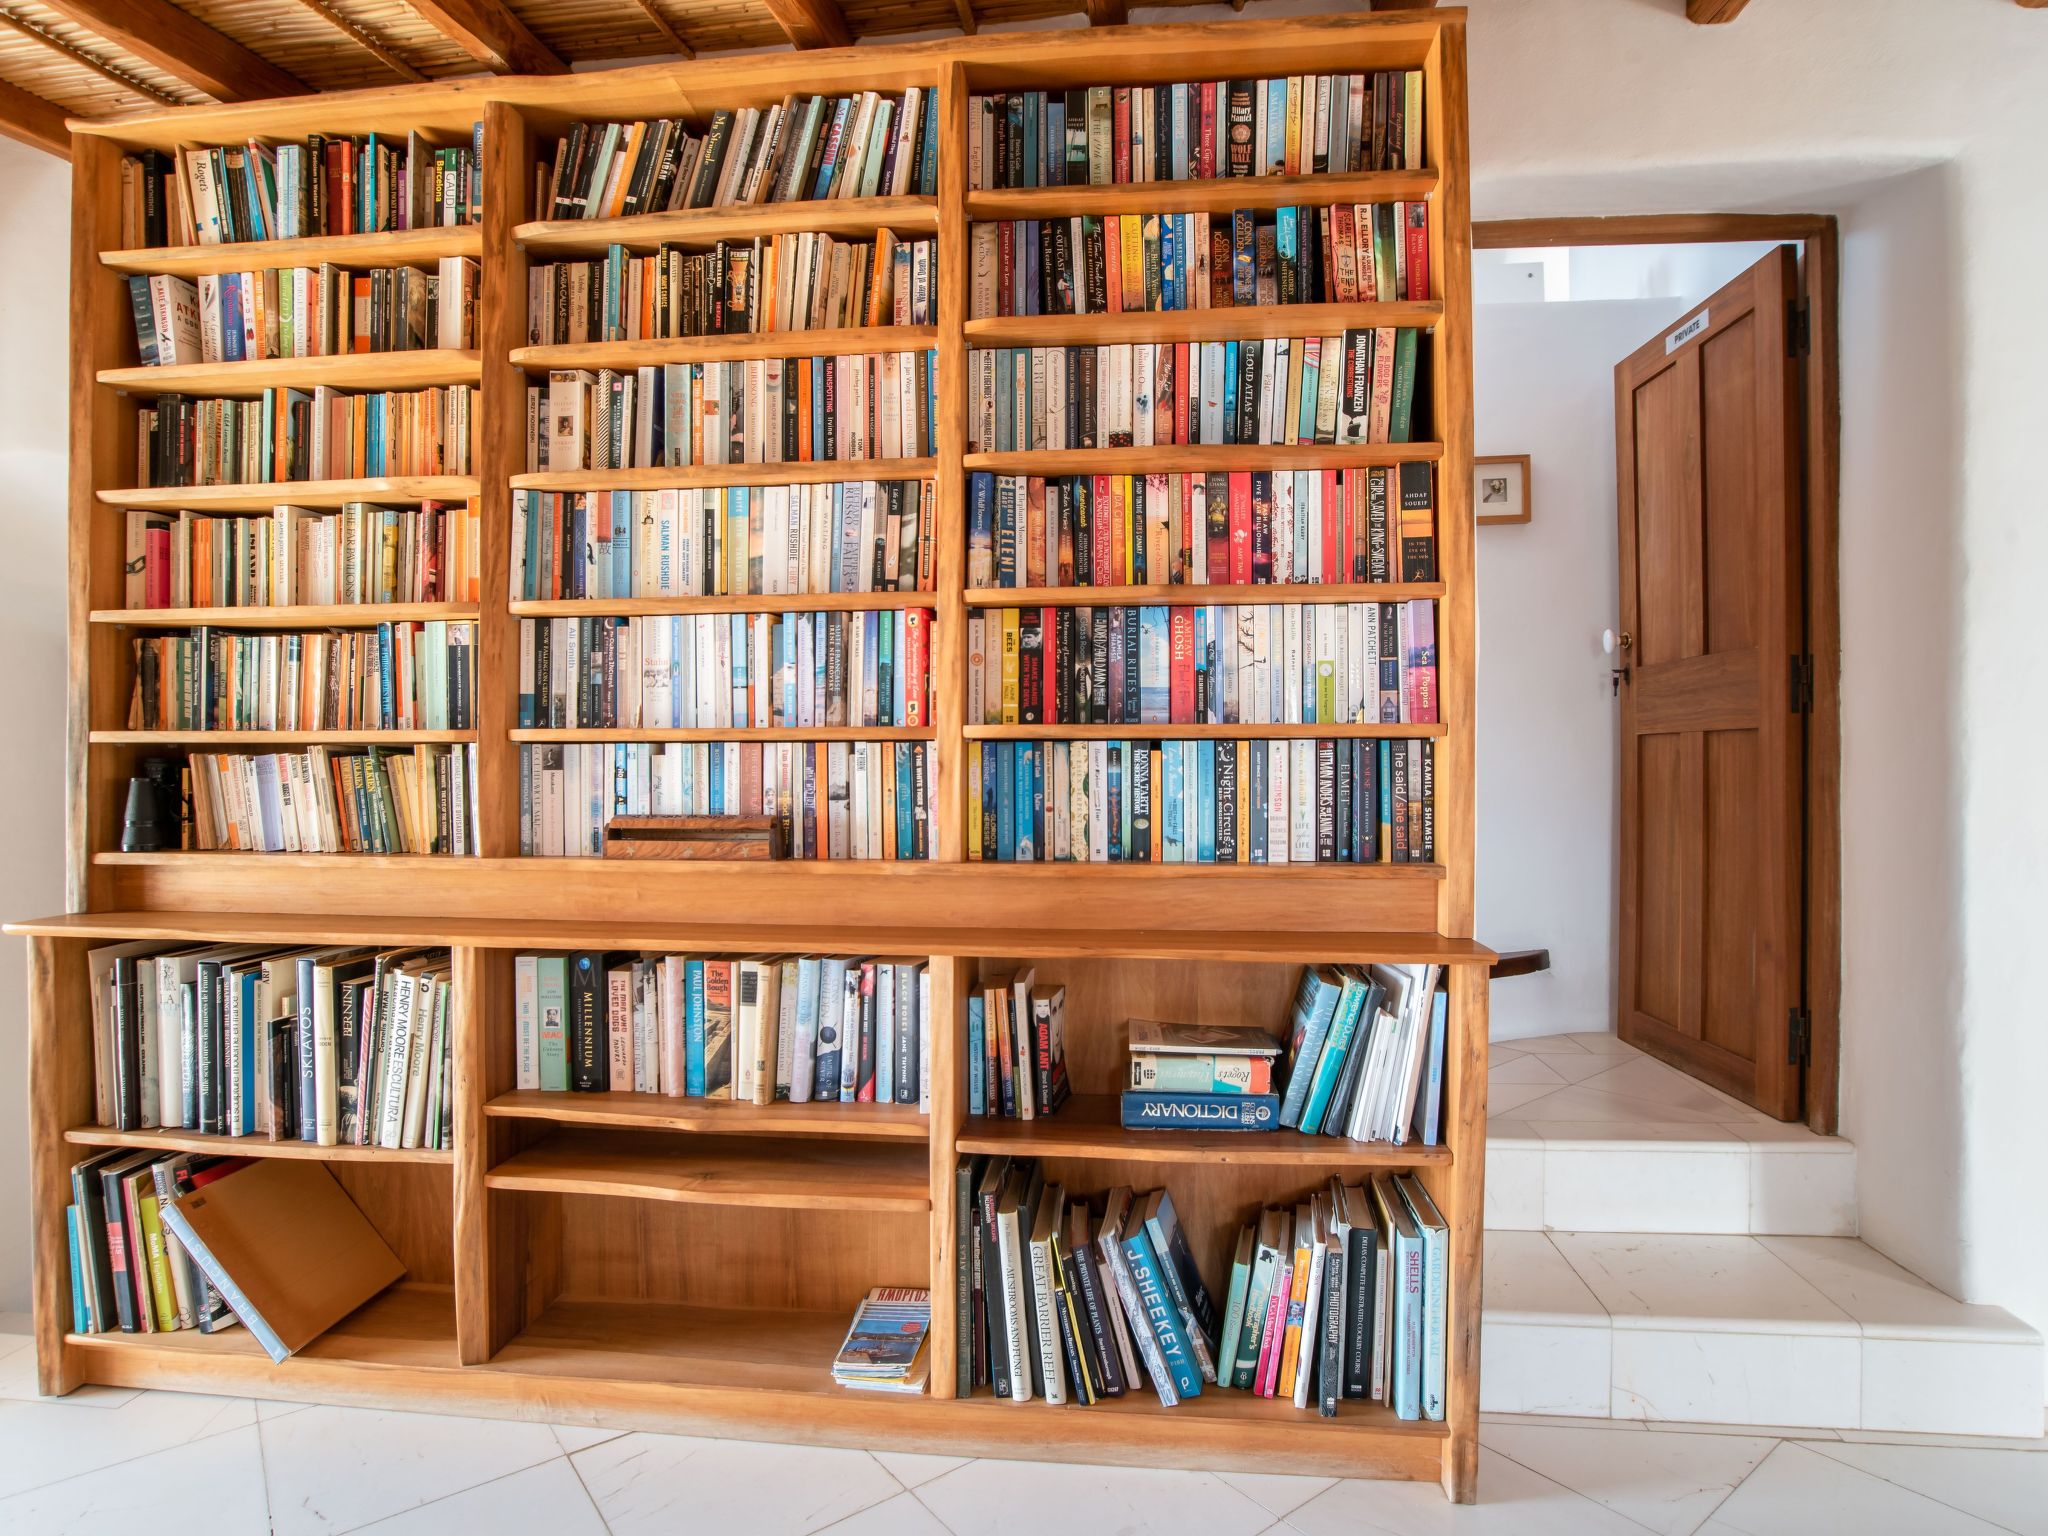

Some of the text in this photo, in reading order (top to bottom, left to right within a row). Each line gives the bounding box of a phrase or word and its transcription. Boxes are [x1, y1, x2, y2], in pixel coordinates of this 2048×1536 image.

[704, 116, 725, 165] My Struggle
[823, 123, 842, 165] CASSINI
[194, 162, 208, 192] Roget's
[435, 160, 444, 202] Barcelona
[658, 149, 674, 180] TALIBAN
[1056, 235, 1064, 271] OUTCAST
[1244, 221, 1252, 244] CONN
[1361, 224, 1370, 255] ELLORY
[682, 262, 692, 291] Victory
[159, 304, 168, 333] ATKINSON
[1674, 320, 1700, 344] PRIVATE
[1353, 335, 1366, 412] JONATHAN FRANZEN
[1244, 383, 1252, 412] ATLAS
[347, 506, 355, 527] THE
[977, 489, 985, 530] Wildflowers
[1016, 493, 1024, 524] Elephant
[1370, 501, 1384, 521] SAVED
[347, 528, 355, 545] FAR
[661, 520, 670, 590] SALMAN RUSHDIE
[790, 528, 798, 561] RUSHDIE
[1001, 529, 1014, 572] ELENI
[1370, 528, 1384, 545] KING
[1371, 548, 1385, 575] SWEDEN
[1128, 610, 1136, 692] BURIAL RITES
[1175, 615, 1183, 660] GHOSH
[1368, 607, 1377, 666] ANN PATCHETT
[354, 757, 363, 789] TOLKIEN
[364, 757, 376, 792] TOLKIEN
[1140, 749, 1149, 814] DONNA TARTT
[1320, 750, 1333, 778] HITMAN
[1340, 764, 1350, 804] ELMET
[1220, 764, 1234, 842] Night Circus
[1320, 780, 1333, 806] ANDERS
[1395, 753, 1407, 850] he said/she said
[343, 985, 353, 1037] BERNINI
[379, 991, 389, 1053] Cornelis ZITMAN
[693, 970, 702, 1042] PAUL JOHNSTON
[1347, 987, 1365, 1025] Lawrence
[300, 1007, 313, 1078] SKLAVOS
[412, 1008, 427, 1077] Henry Moore
[583, 992, 592, 1068] MILLENNIUM
[387, 980, 411, 1123] HENRY MOORE ESCULTURA
[1040, 1052, 1049, 1070] ANT
[1142, 1103, 1237, 1118] DICTIONARY
[150, 1233, 159, 1258] MoMA
[1076, 1249, 1103, 1335] THE PRIVATE LIFE OF PLANTS
[1409, 1251, 1420, 1294] SHELLS
[1006, 1268, 1018, 1325] MUSHROOMS
[1032, 1246, 1056, 1384] GREAT BARRIER REEF
[1126, 1250, 1182, 1356] J.SHEEKEY
[1328, 1291, 1340, 1344] PHOTOGRAPHY
